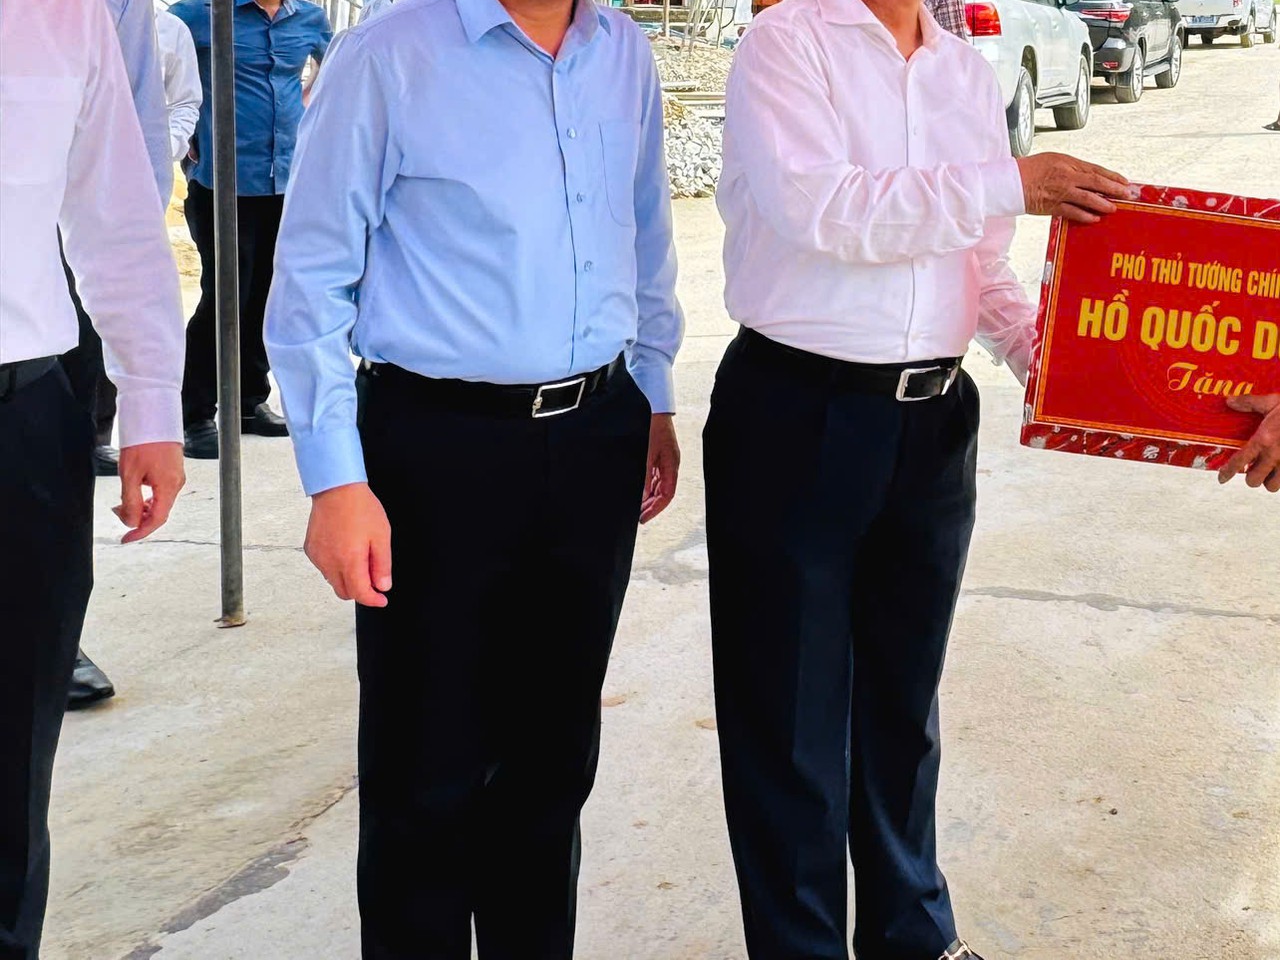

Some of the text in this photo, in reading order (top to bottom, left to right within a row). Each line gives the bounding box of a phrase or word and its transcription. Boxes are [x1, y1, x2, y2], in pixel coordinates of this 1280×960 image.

[1110, 250, 1146, 281] PHÓ
[1151, 252, 1184, 286] THỦ
[1187, 260, 1243, 294] TƯỚNG
[1077, 289, 1130, 341] HỒ
[1140, 301, 1242, 356] QUỐC
